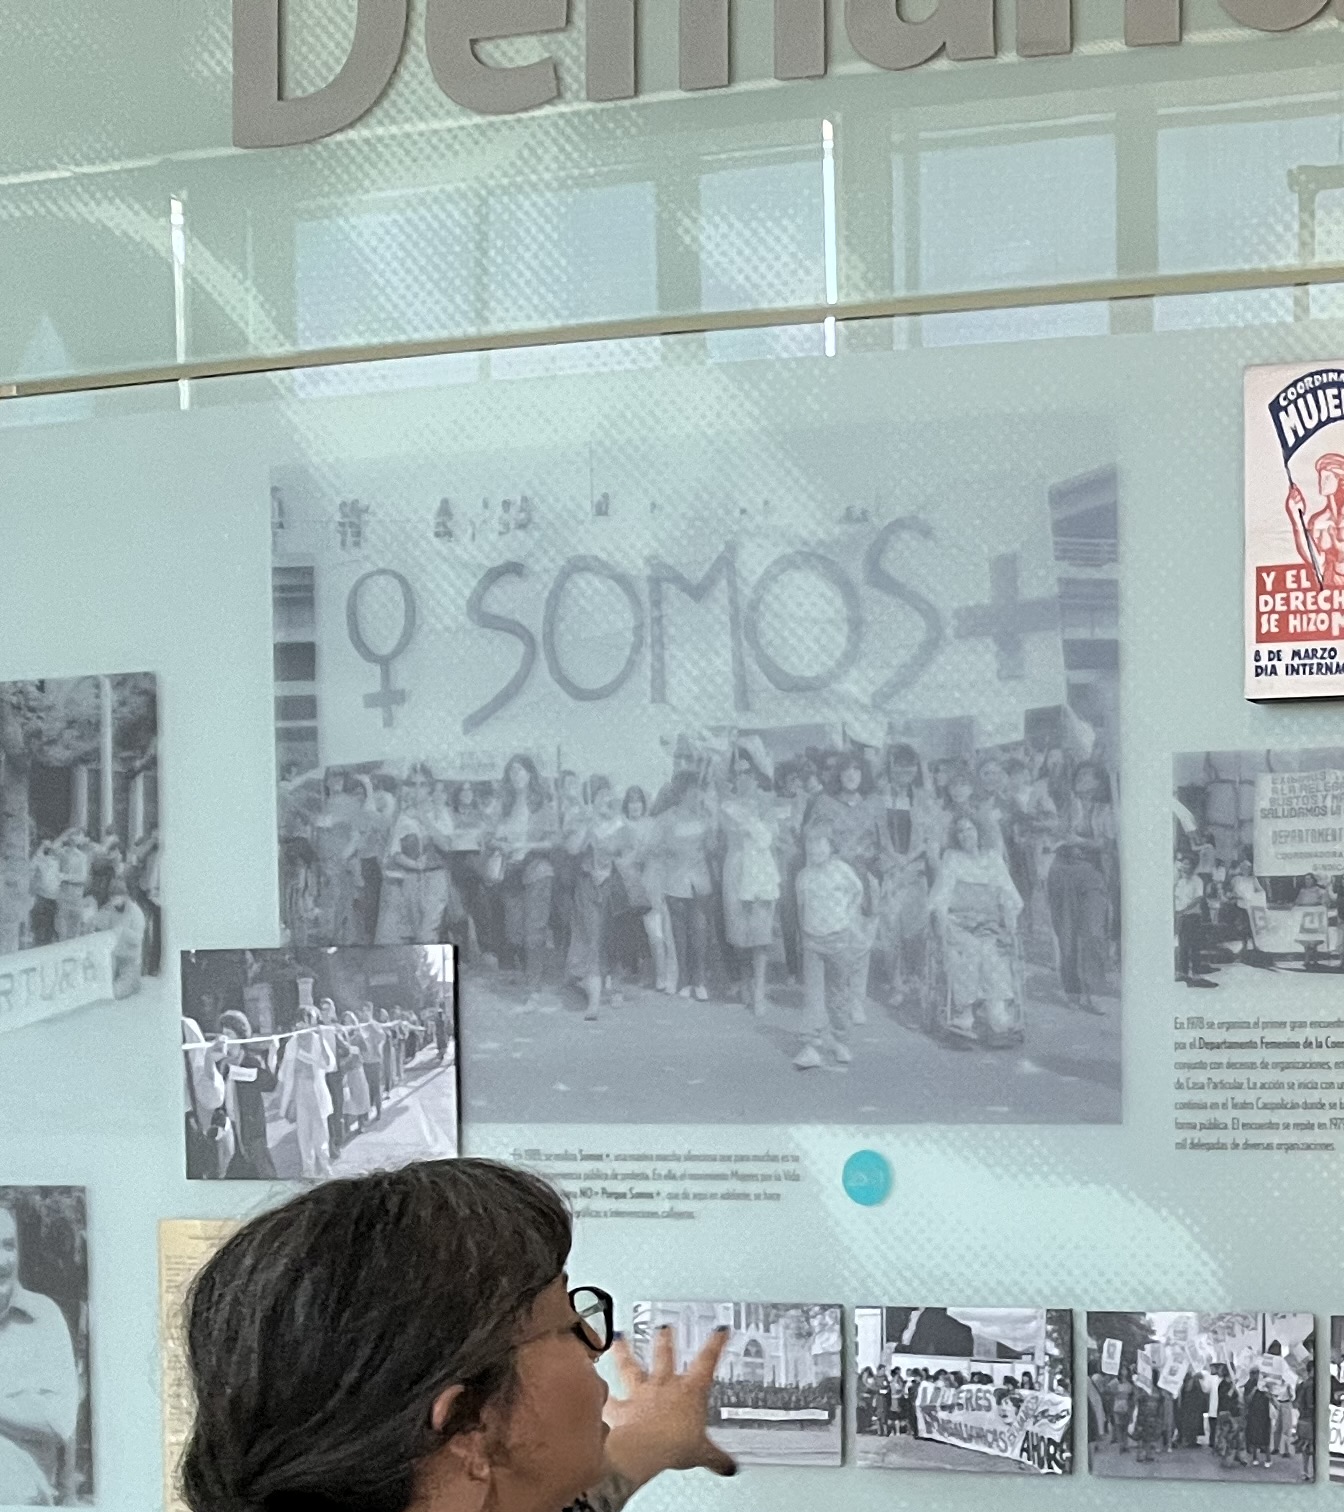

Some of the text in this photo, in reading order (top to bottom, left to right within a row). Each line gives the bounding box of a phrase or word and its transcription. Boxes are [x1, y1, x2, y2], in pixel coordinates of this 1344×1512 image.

[1262, 569, 1311, 591] Y EL
[1260, 614, 1279, 634] SE
[1289, 612, 1330, 633] HIZO
[1254, 647, 1337, 662] 8 DE MARZO
[1255, 664, 1278, 677] DIA
